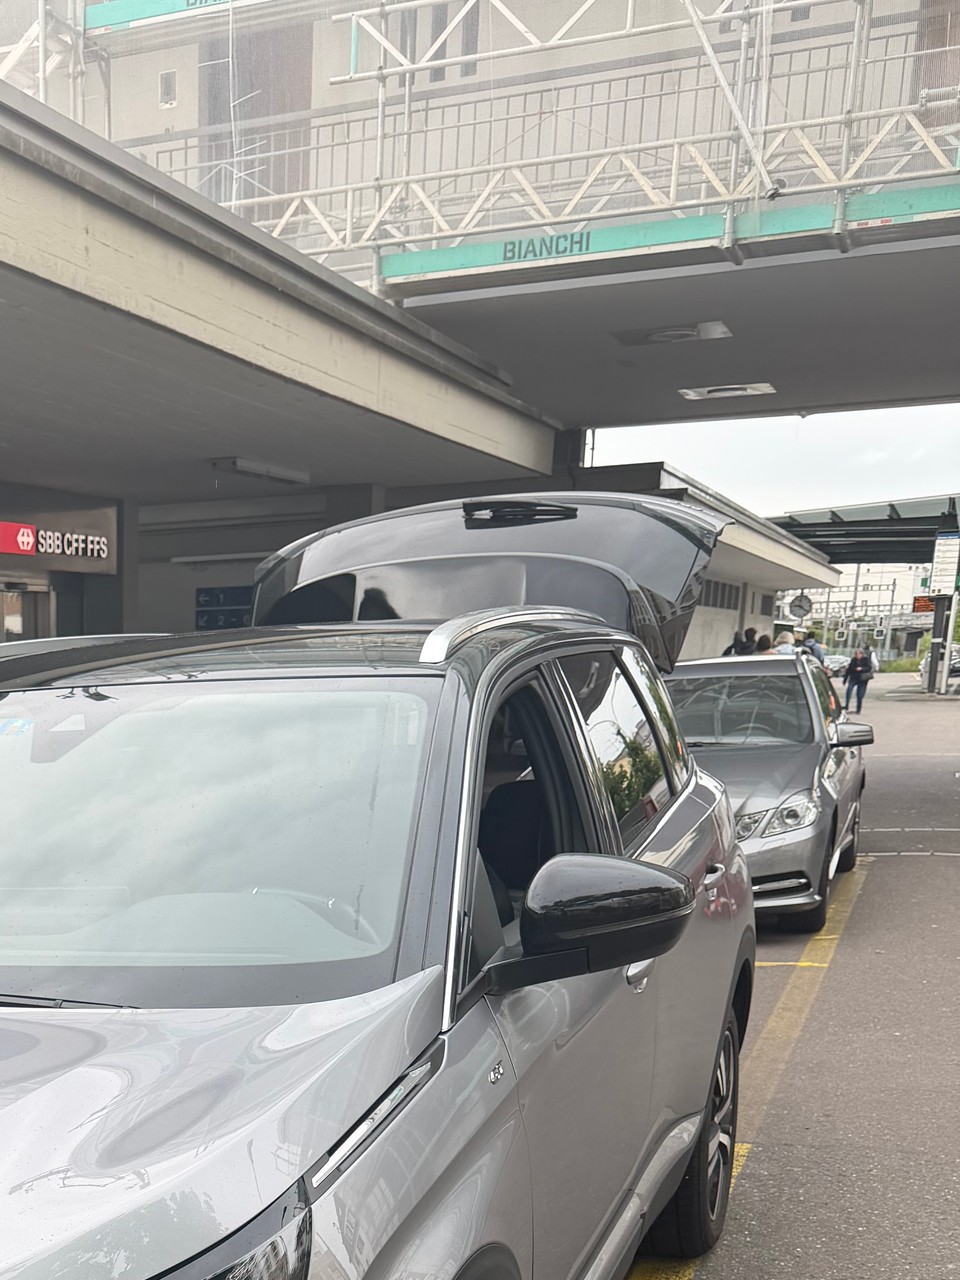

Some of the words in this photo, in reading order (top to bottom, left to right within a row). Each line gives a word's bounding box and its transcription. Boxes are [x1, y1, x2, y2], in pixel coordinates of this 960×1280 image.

[503, 231, 591, 261] BIANCHI
[38, 530, 62, 554] SBB
[63, 533, 86, 556] CFF
[87, 535, 108, 559] FFS
